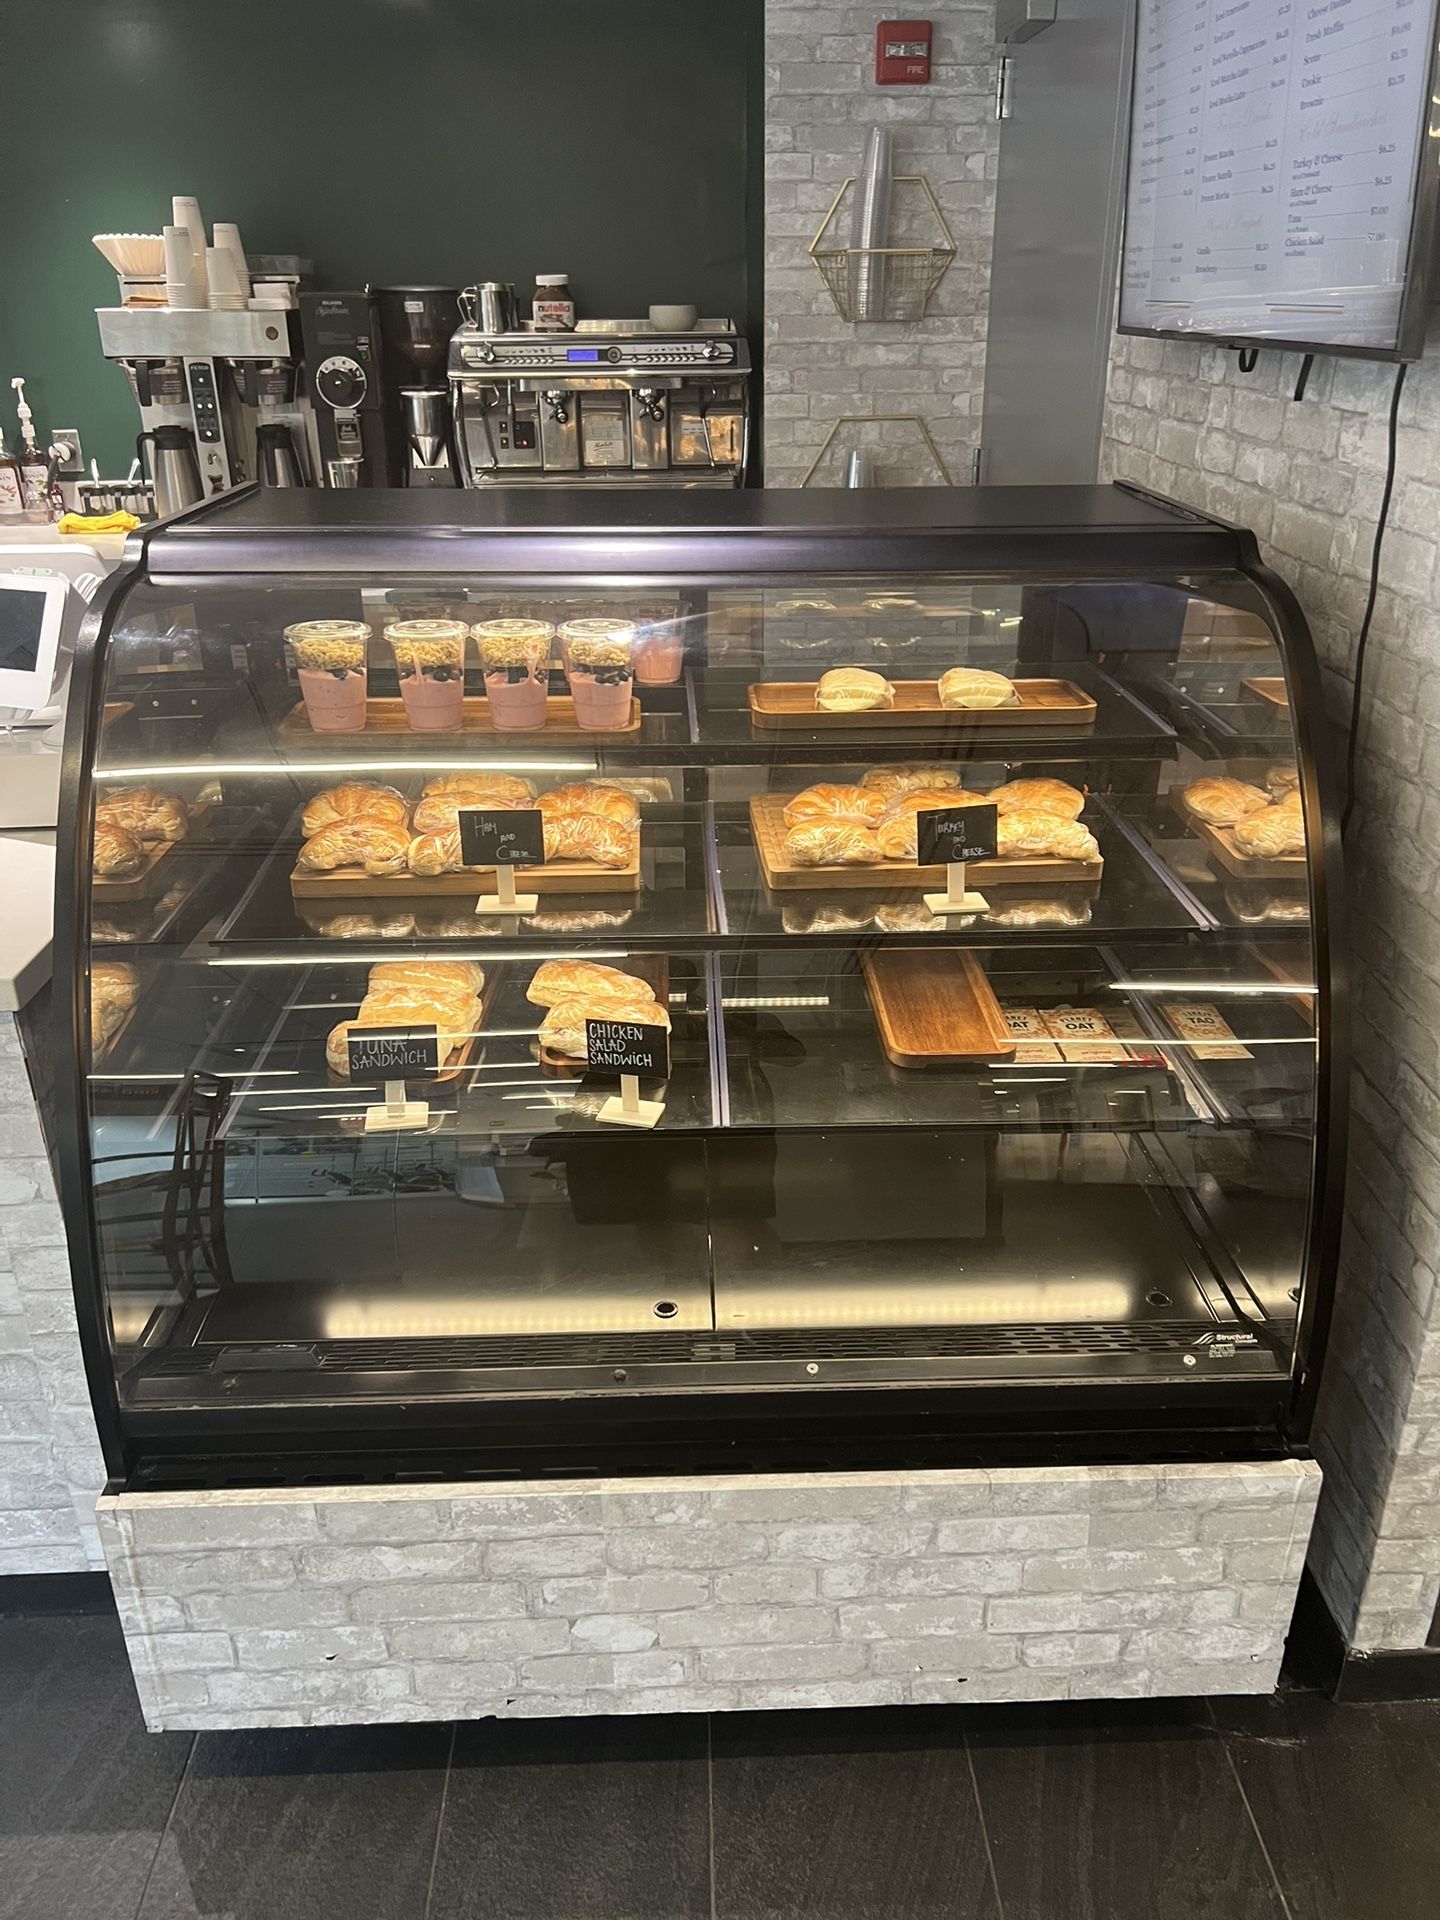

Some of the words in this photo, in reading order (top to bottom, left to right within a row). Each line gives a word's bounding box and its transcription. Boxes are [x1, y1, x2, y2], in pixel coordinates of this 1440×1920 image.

[906, 65, 925, 74] FIRE
[538, 302, 570, 313] nutella
[589, 1021, 643, 1041] CHICKEN
[1065, 1022, 1095, 1030] OAT
[359, 1039, 407, 1055] TUNA
[589, 1038, 626, 1053] SALAD
[352, 1049, 427, 1070] SANDWICH
[590, 1051, 653, 1068] SANDWICH
[1216, 1332, 1253, 1341] Structural
